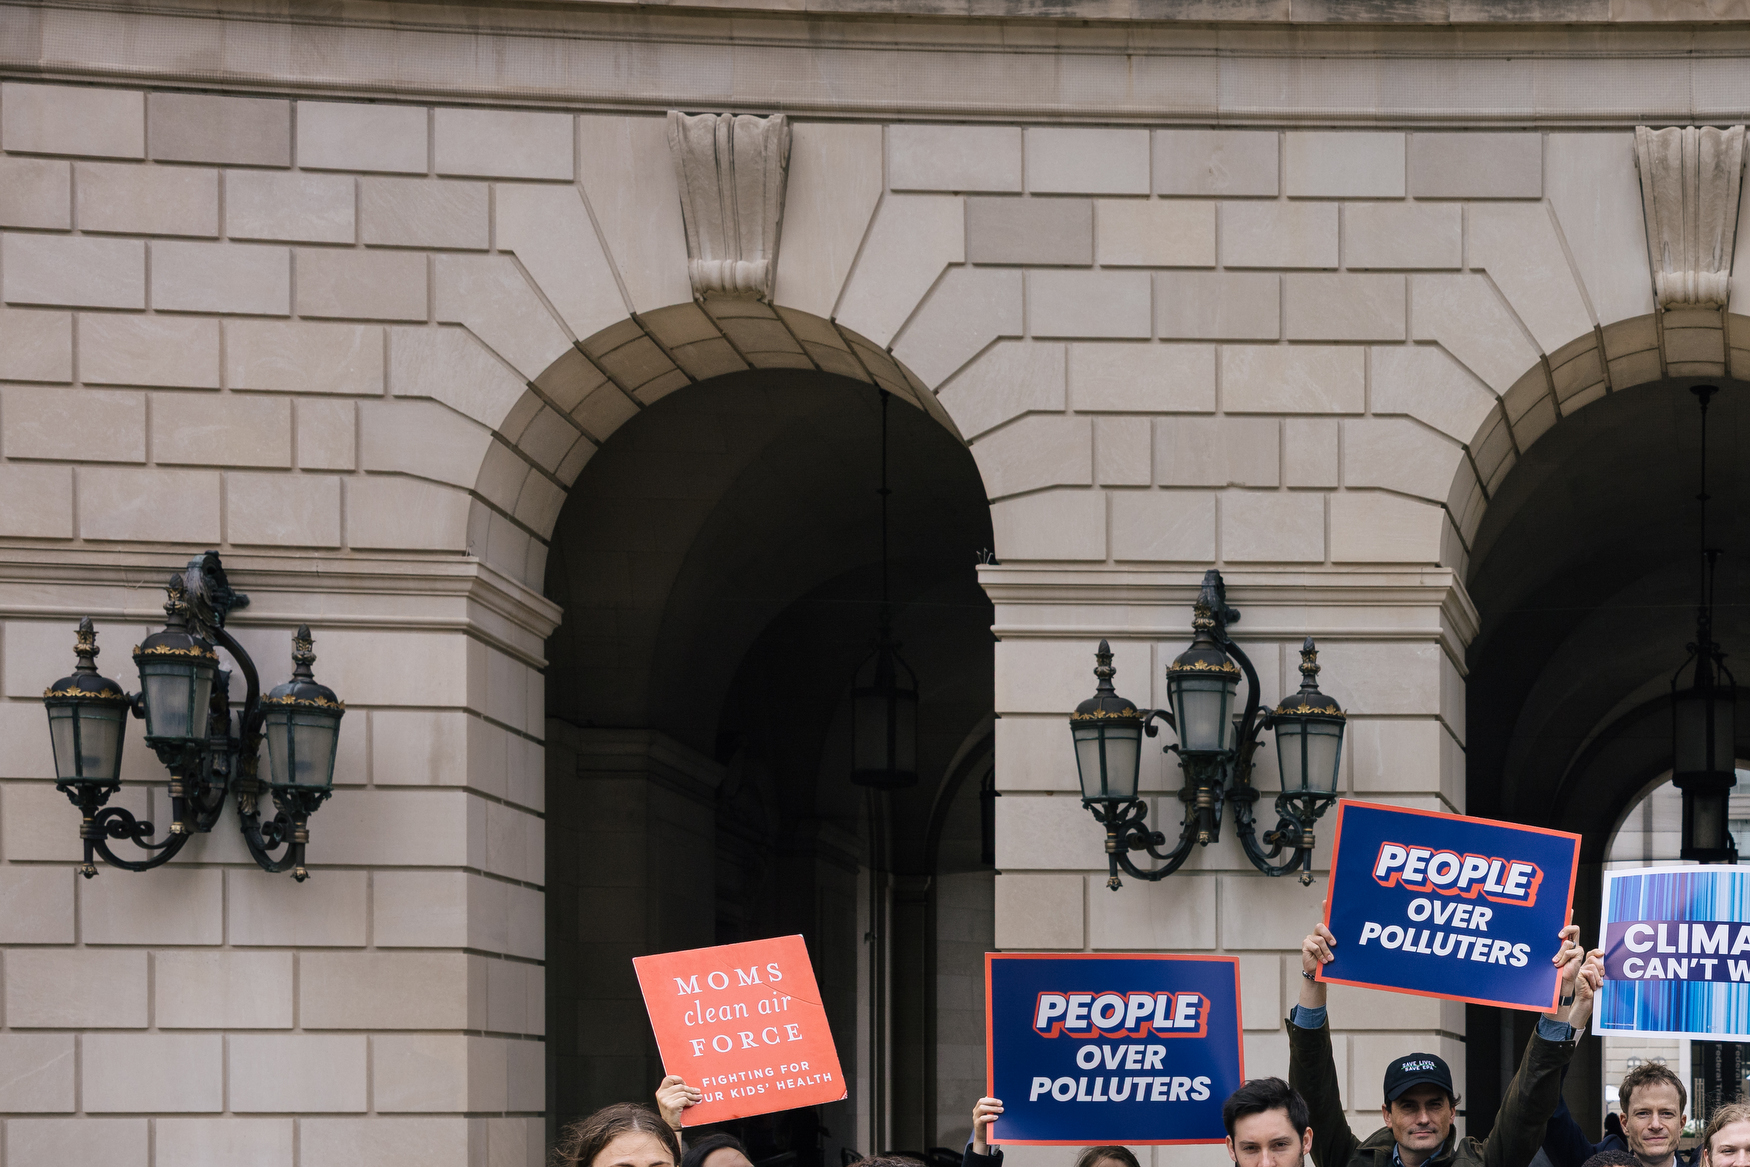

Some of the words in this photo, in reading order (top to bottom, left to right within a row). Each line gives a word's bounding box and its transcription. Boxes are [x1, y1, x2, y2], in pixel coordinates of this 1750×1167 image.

[1375, 844, 1535, 897] PEOPLE
[1407, 897, 1493, 931] OVER
[1359, 921, 1531, 967] POLLUTERS
[673, 962, 783, 996] MOMS
[1623, 957, 1718, 980] CAN'T
[684, 1000, 749, 1026] clean
[758, 991, 791, 1015] air
[1036, 993, 1202, 1029] PEOPLE
[689, 1023, 803, 1057] FORCE
[702, 1067, 774, 1087] FIGHTING
[781, 1061, 810, 1073] FOR
[1076, 1045, 1167, 1070] OVER
[777, 1072, 832, 1090] HEALTH
[1029, 1076, 1212, 1102] POLLUTERS
